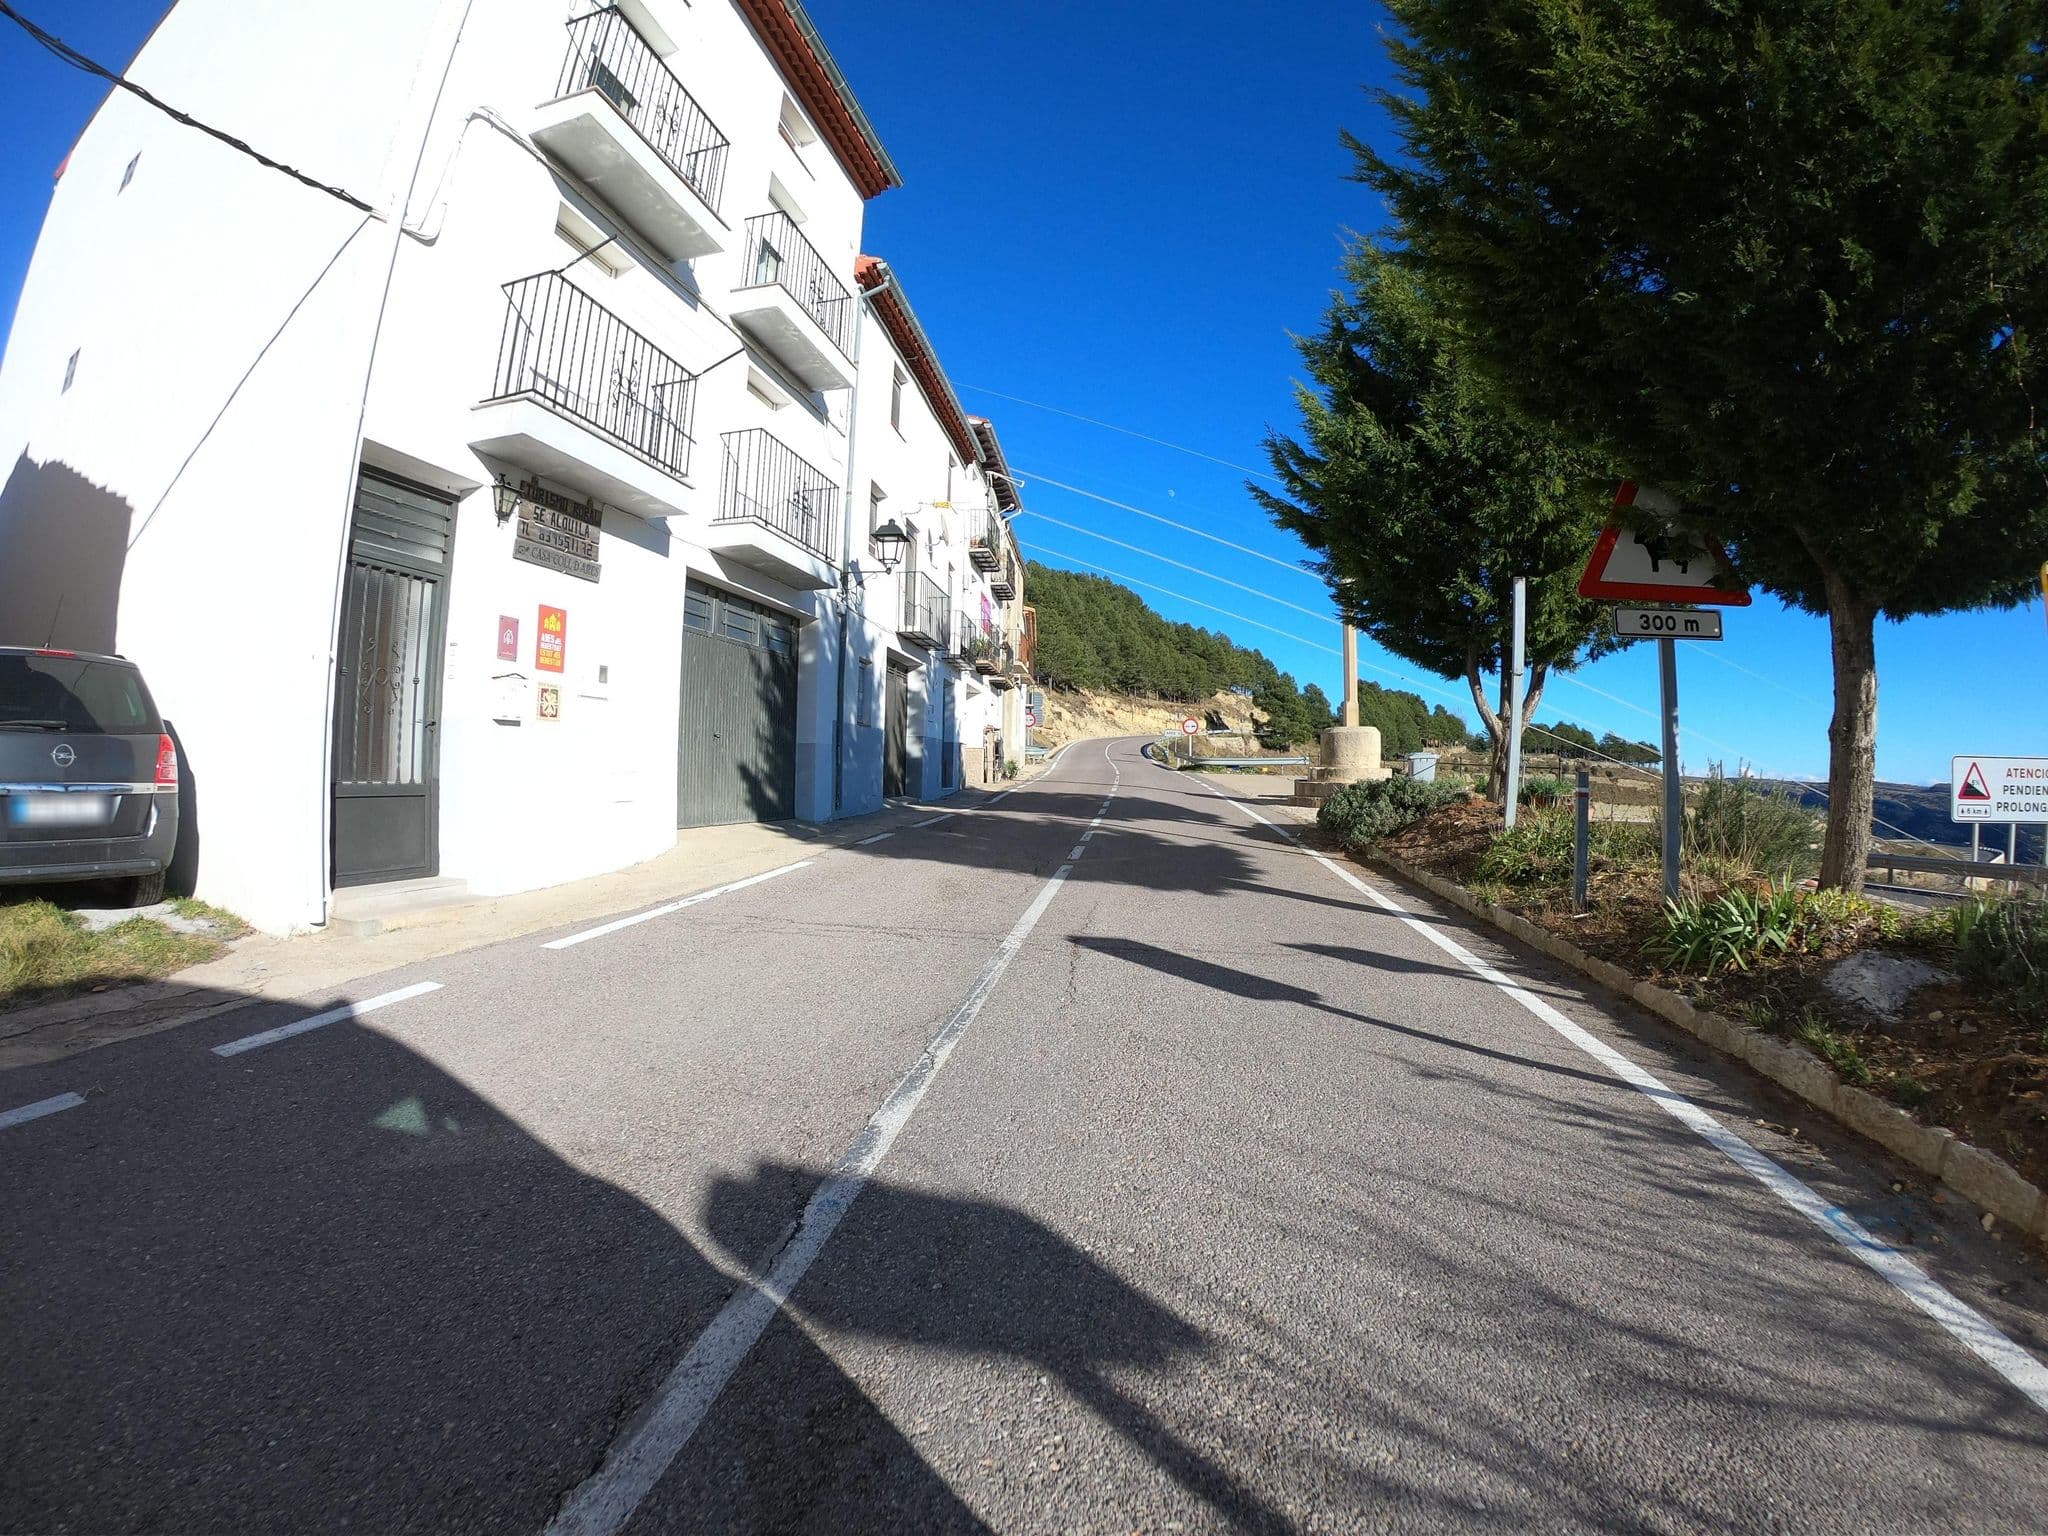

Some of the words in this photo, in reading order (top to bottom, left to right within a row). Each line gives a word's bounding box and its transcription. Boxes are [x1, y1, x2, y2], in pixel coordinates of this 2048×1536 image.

[533, 505, 546, 523] SE
[550, 512, 590, 539] ALQUILA
[1639, 614, 1676, 631] 300
[1684, 618, 1700, 632] m
[1996, 801, 2048, 813] PROLONG
